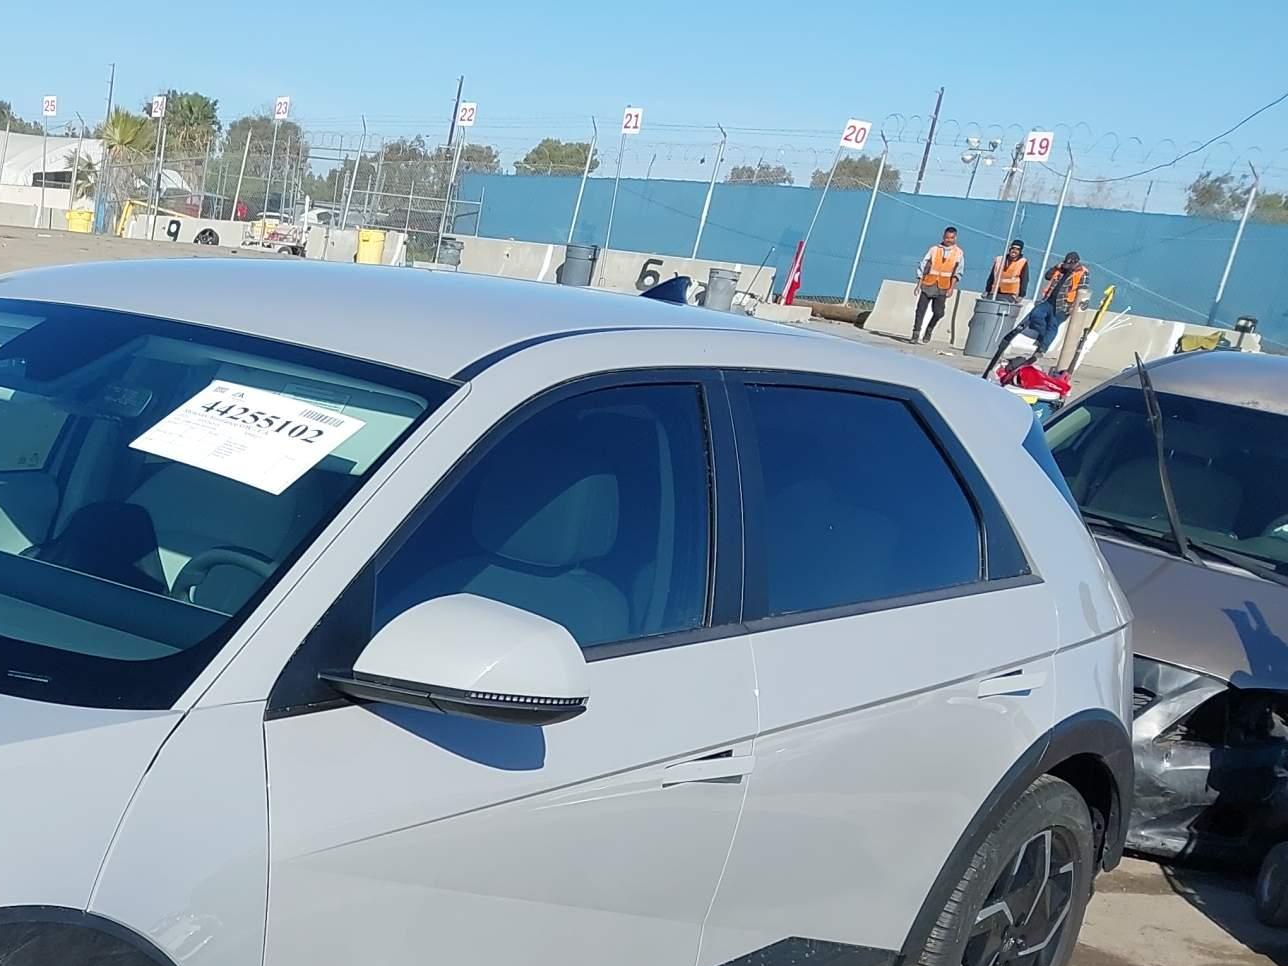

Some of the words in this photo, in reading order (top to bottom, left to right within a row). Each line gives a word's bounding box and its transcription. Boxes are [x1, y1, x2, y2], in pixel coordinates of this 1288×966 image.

[44, 100, 56, 112] 25
[276, 101, 288, 115] 23
[460, 107, 475, 122] 22
[624, 112, 640, 129] 21
[843, 125, 867, 144] 20
[1026, 137, 1050, 156] 19
[167, 219, 181, 242] 9
[635, 258, 664, 291] 6
[201, 400, 324, 443] 44255102
